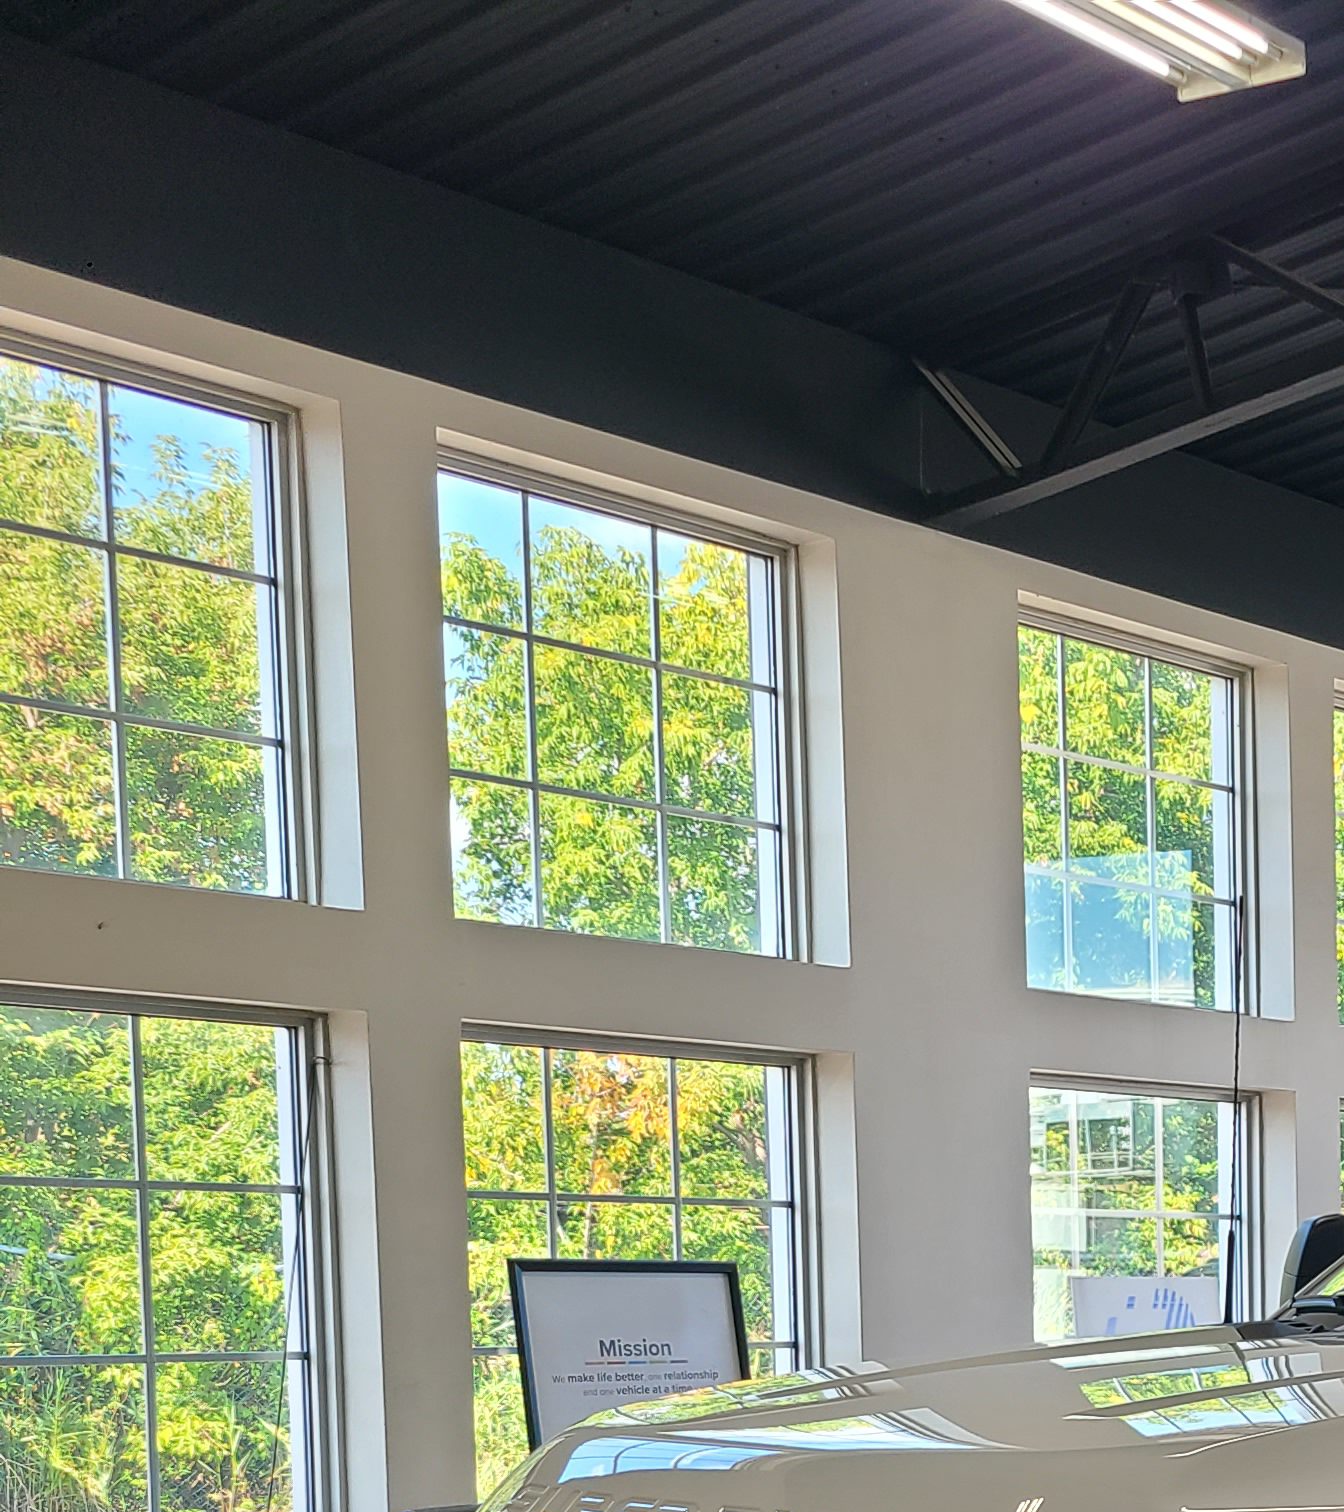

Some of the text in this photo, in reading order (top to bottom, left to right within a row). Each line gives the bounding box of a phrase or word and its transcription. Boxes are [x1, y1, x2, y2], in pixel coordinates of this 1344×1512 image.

[599, 1338, 672, 1357] Mission
[567, 1373, 595, 1383] make
[597, 1371, 613, 1382] life
[664, 1370, 719, 1381] relationship
[616, 1385, 650, 1395] vehicle
[652, 1384, 662, 1394] at
